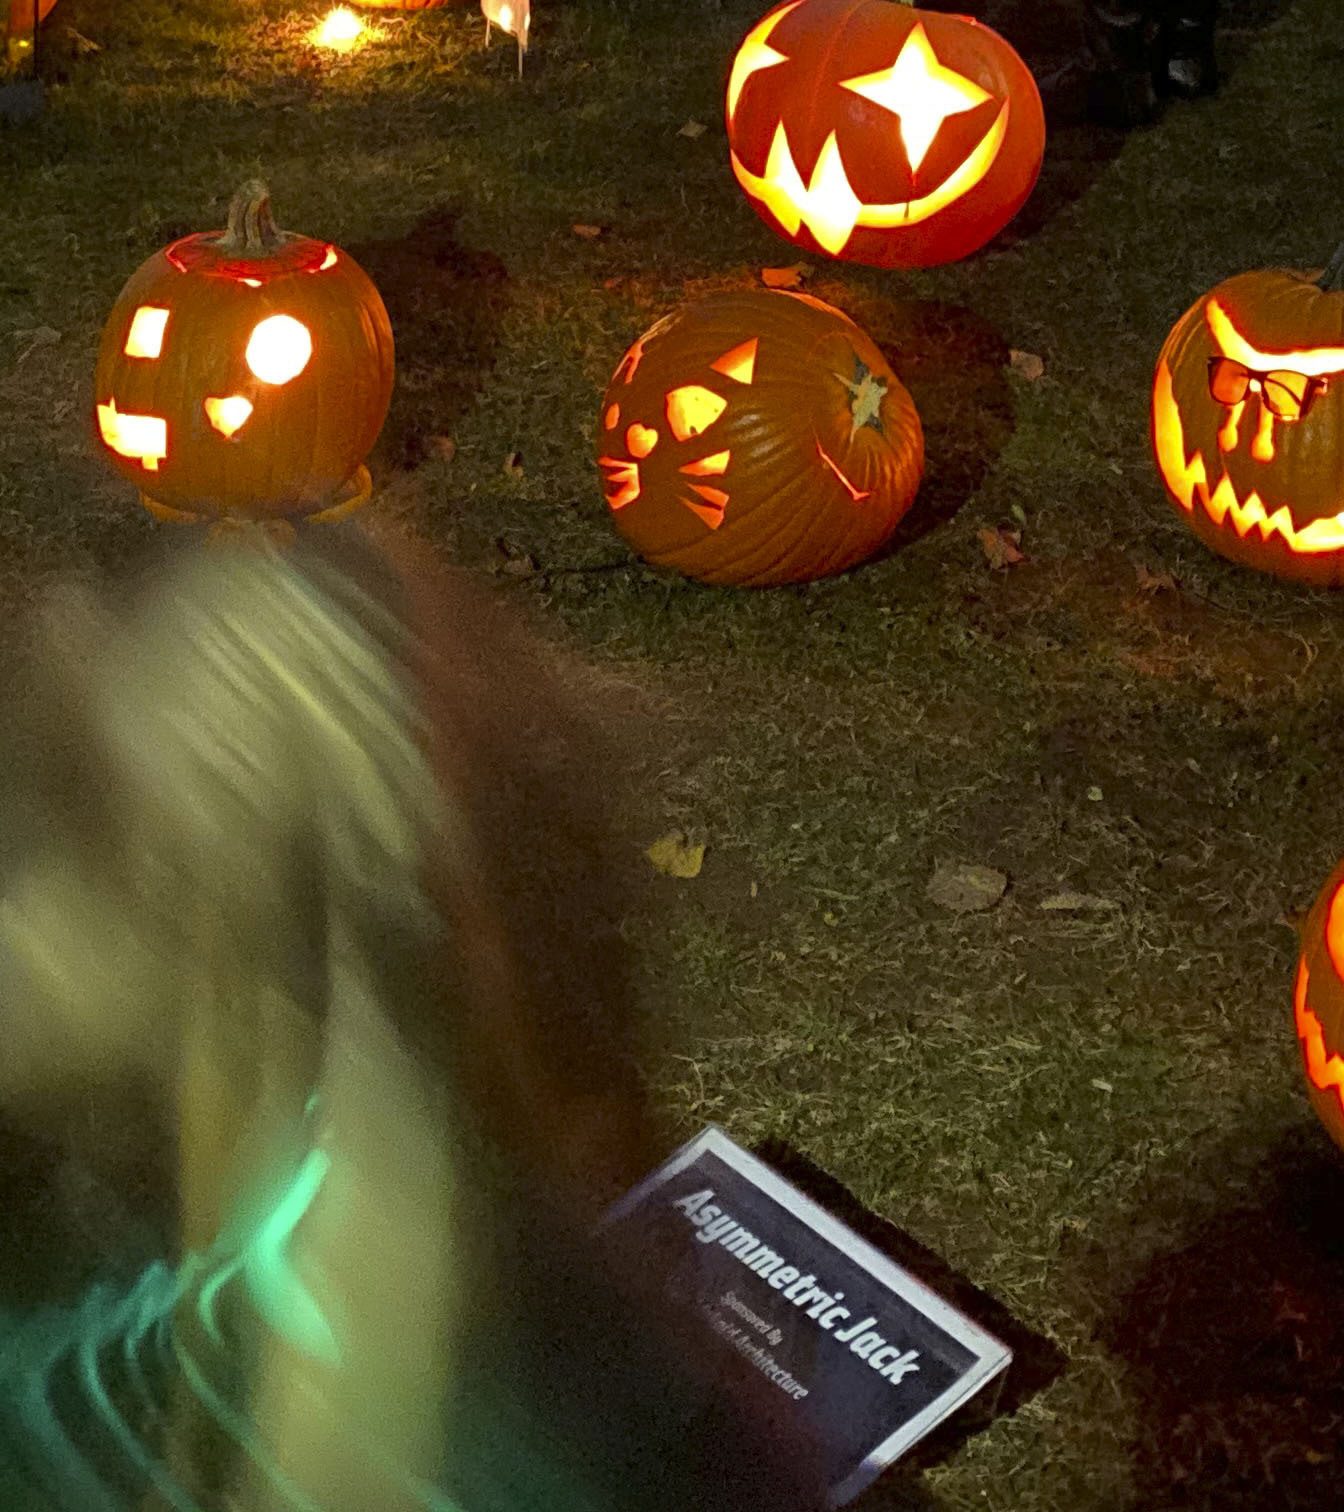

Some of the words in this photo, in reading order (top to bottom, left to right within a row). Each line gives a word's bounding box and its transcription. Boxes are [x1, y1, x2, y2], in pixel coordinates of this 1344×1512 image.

[673, 1189, 850, 1331] Asymmetric
[834, 1317, 920, 1386] Jack
[720, 1291, 774, 1335] Sponsored
[766, 1328, 784, 1346] By
[736, 1335, 809, 1400] Architecture
